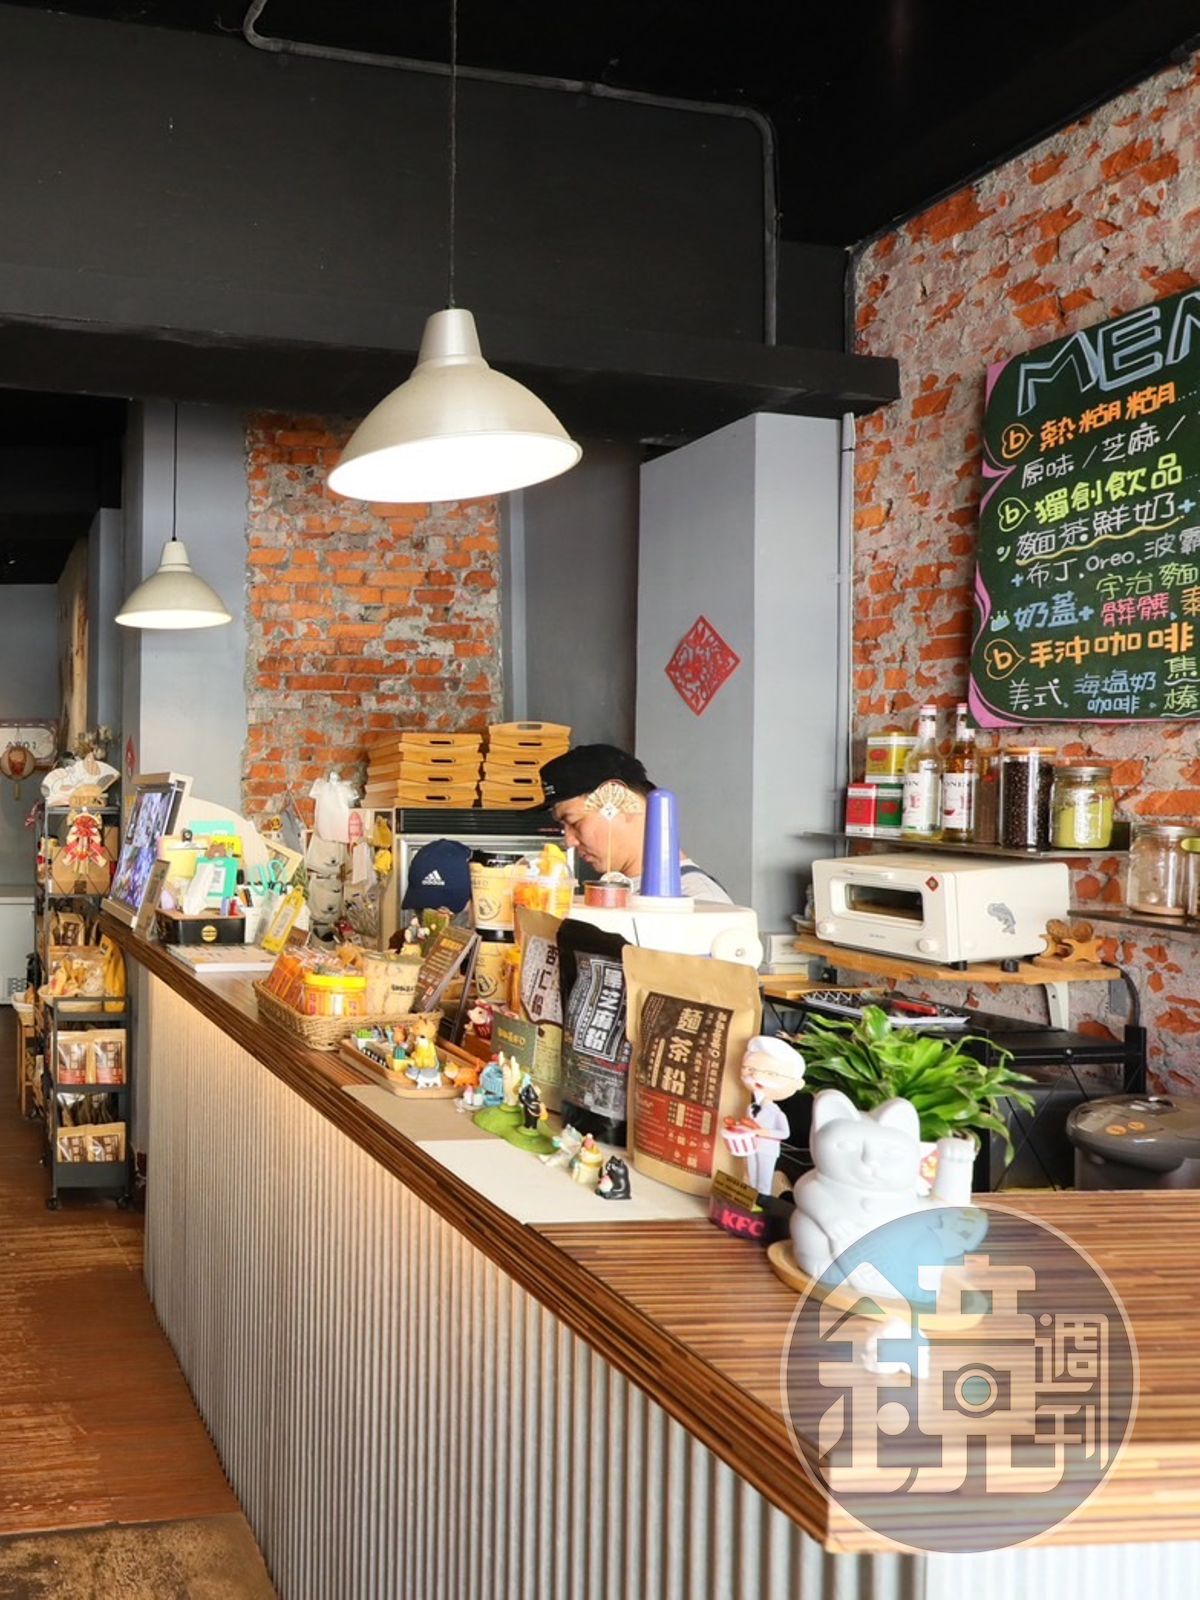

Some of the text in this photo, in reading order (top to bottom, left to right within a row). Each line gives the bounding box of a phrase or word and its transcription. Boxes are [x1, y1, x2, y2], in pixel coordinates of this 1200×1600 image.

[1034, 453, 1182, 524] 獨創飲品
[720, 1209, 765, 1237] KFC
